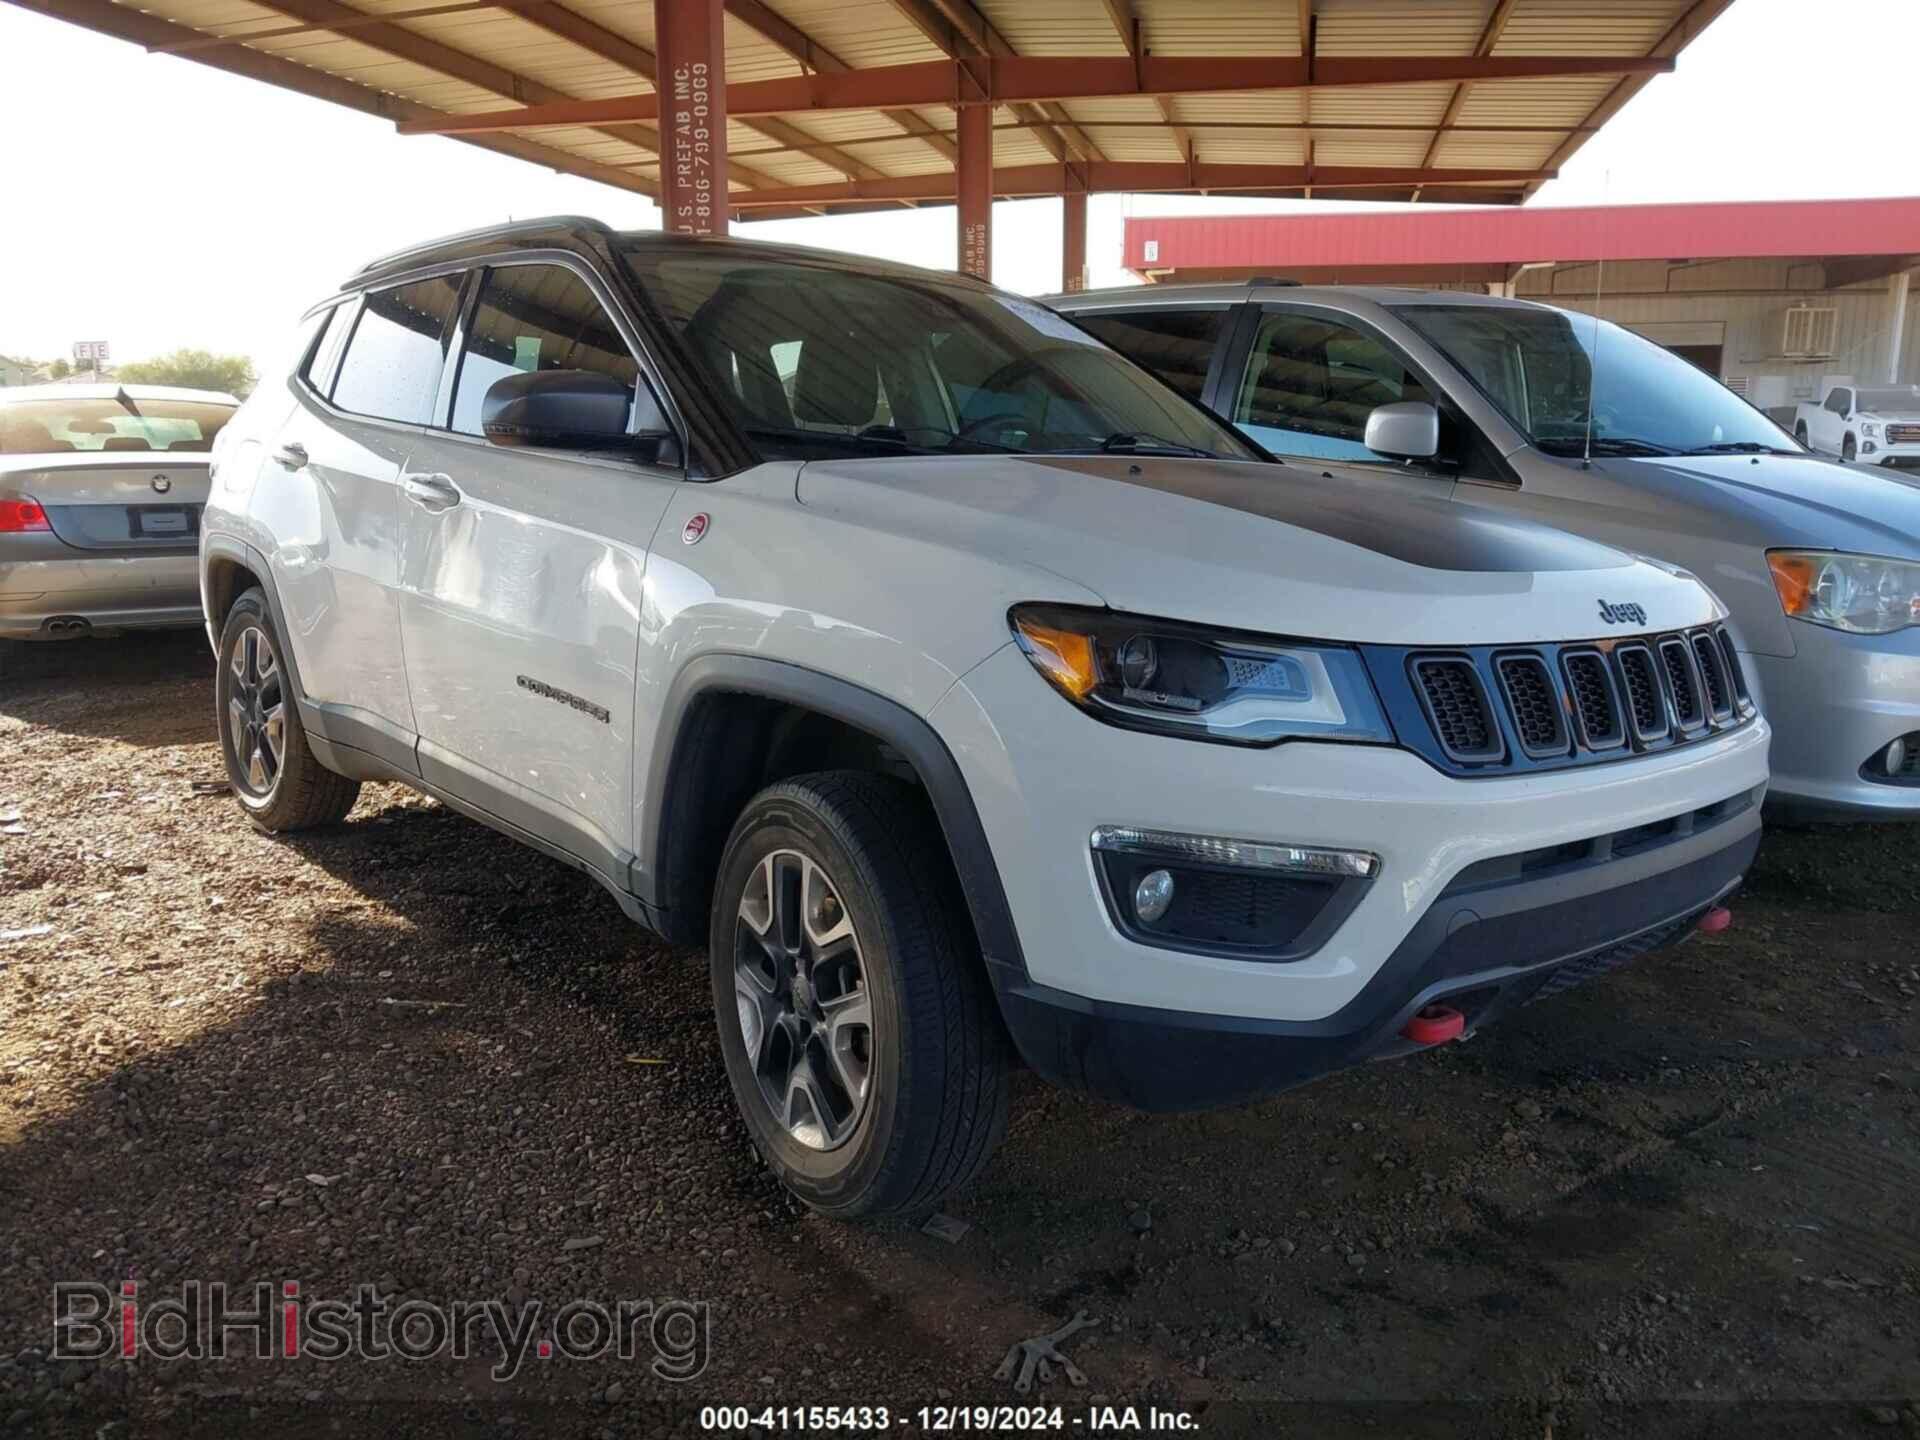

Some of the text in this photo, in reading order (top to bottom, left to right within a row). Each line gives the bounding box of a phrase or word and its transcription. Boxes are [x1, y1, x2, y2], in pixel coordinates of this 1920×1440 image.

[674, 62, 690, 100] INC.
[676, 111, 692, 189] PREFAB
[692, 63, 712, 234] 1-866-799-0969
[1597, 599, 1647, 626] Jeep
